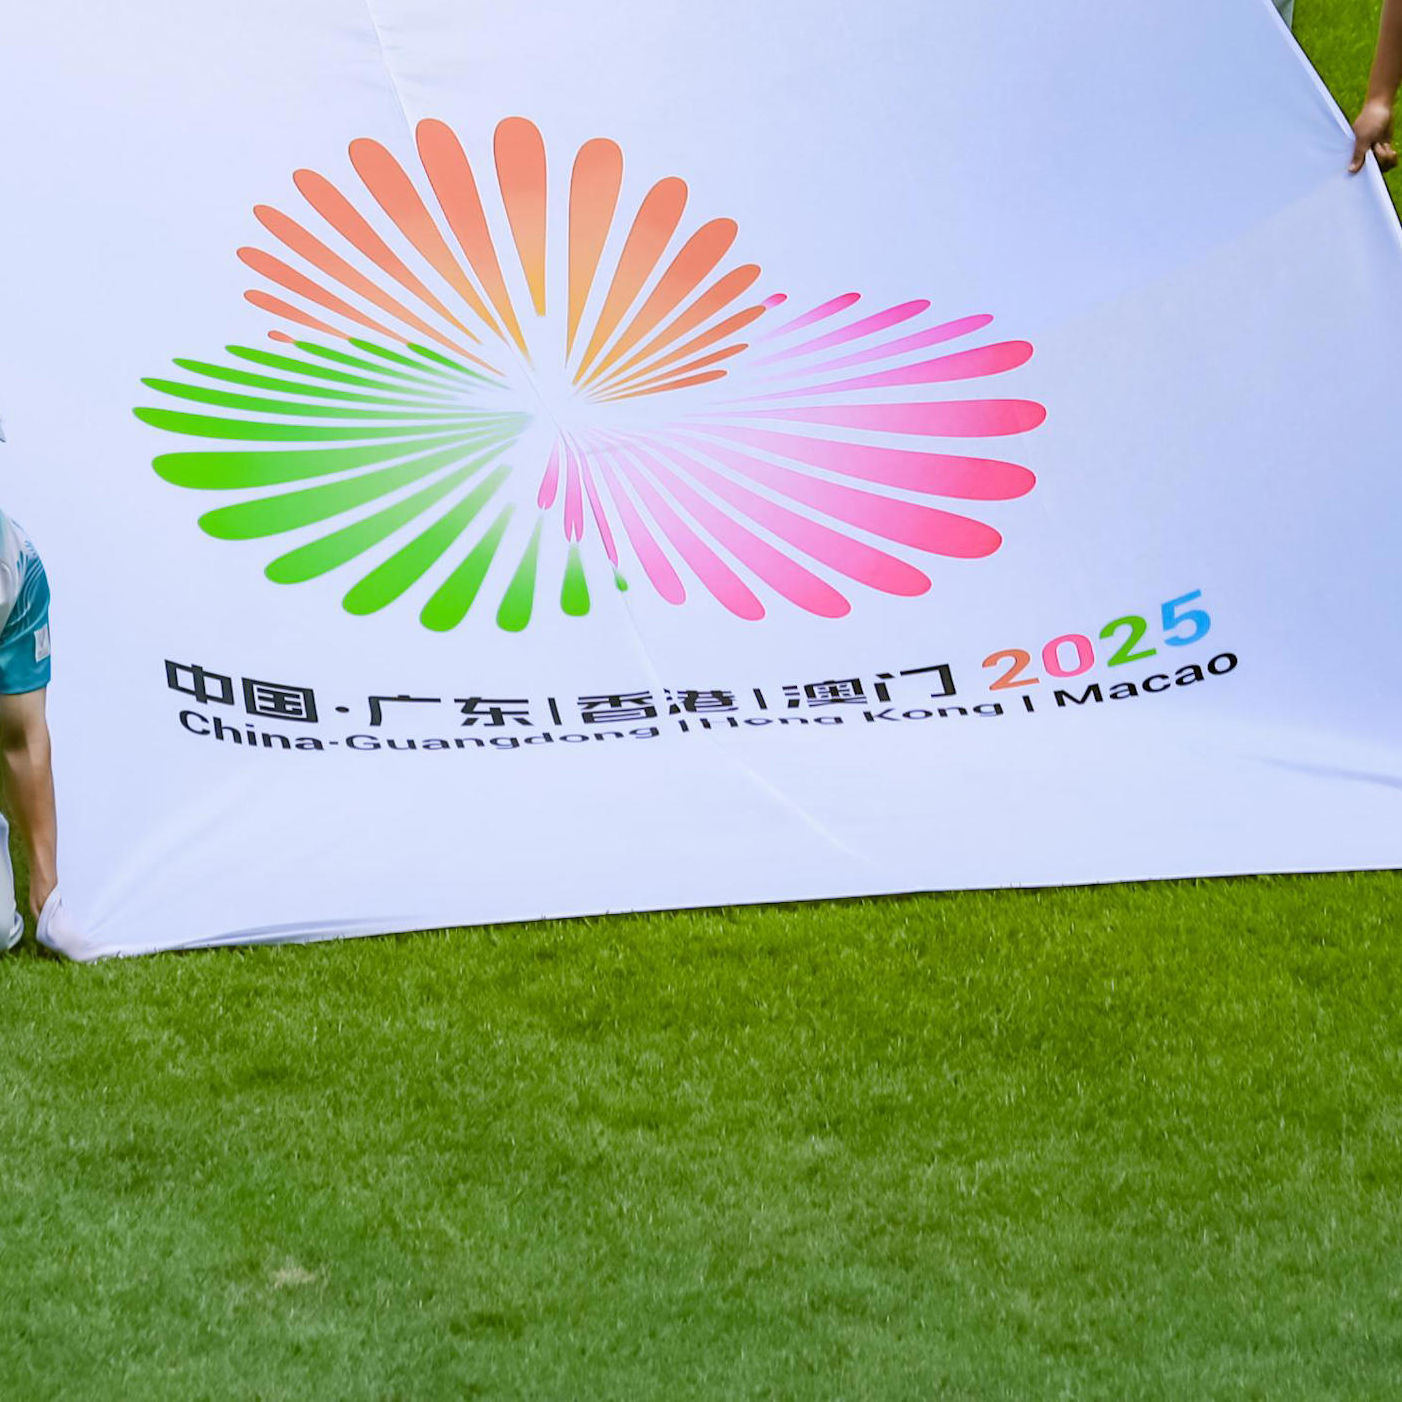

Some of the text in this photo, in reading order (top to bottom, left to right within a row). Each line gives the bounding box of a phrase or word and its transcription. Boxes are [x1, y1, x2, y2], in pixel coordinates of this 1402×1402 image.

[982, 589, 1212, 691] 2025
[862, 704, 1005, 724] Kong
[1053, 652, 1239, 708] Macao
